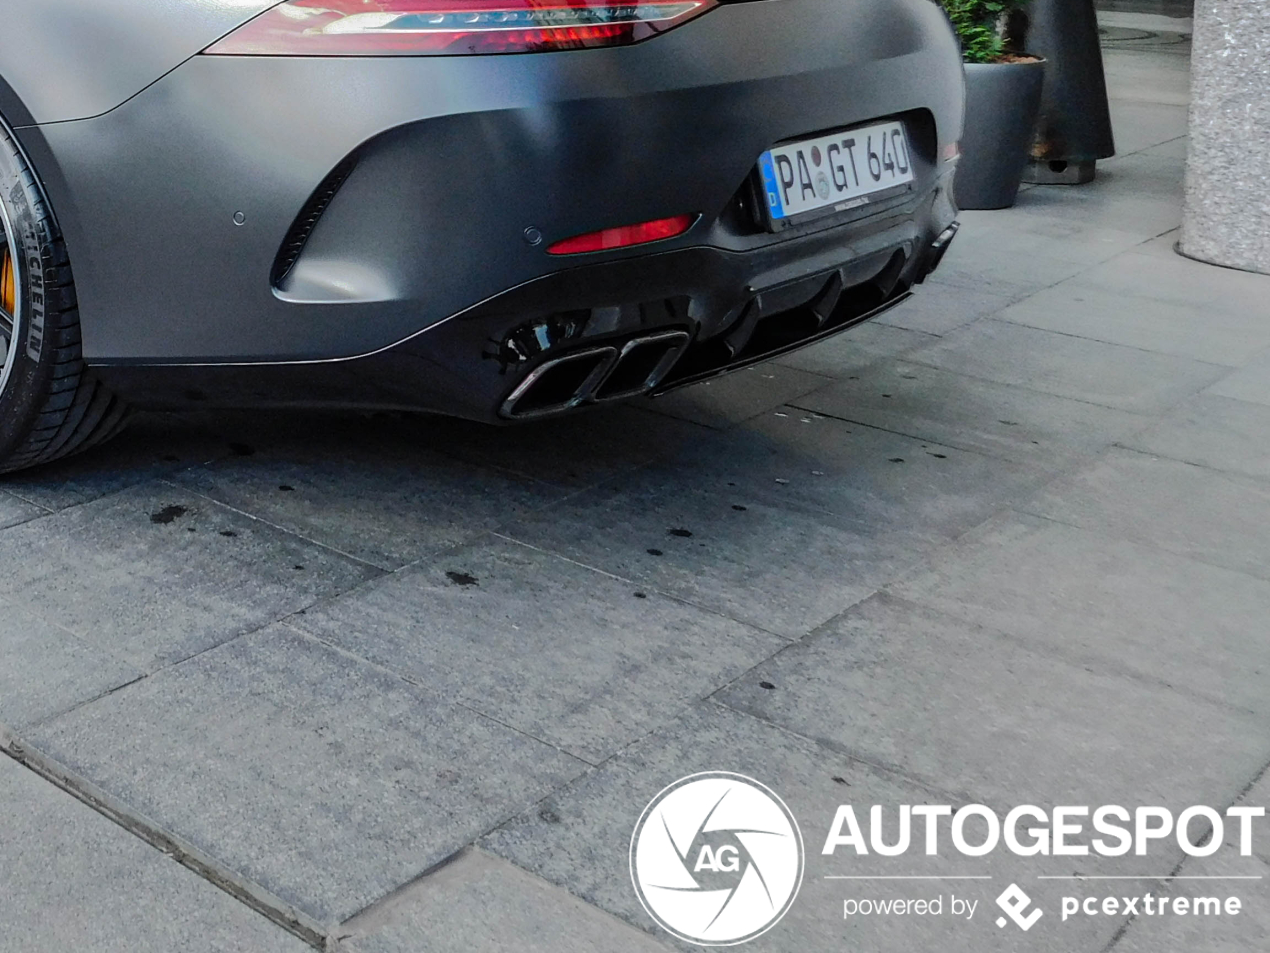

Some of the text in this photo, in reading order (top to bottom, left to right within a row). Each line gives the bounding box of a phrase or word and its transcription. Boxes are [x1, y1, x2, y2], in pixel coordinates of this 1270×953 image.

[774, 128, 909, 206] PA GT 640
[768, 191, 777, 207] D
